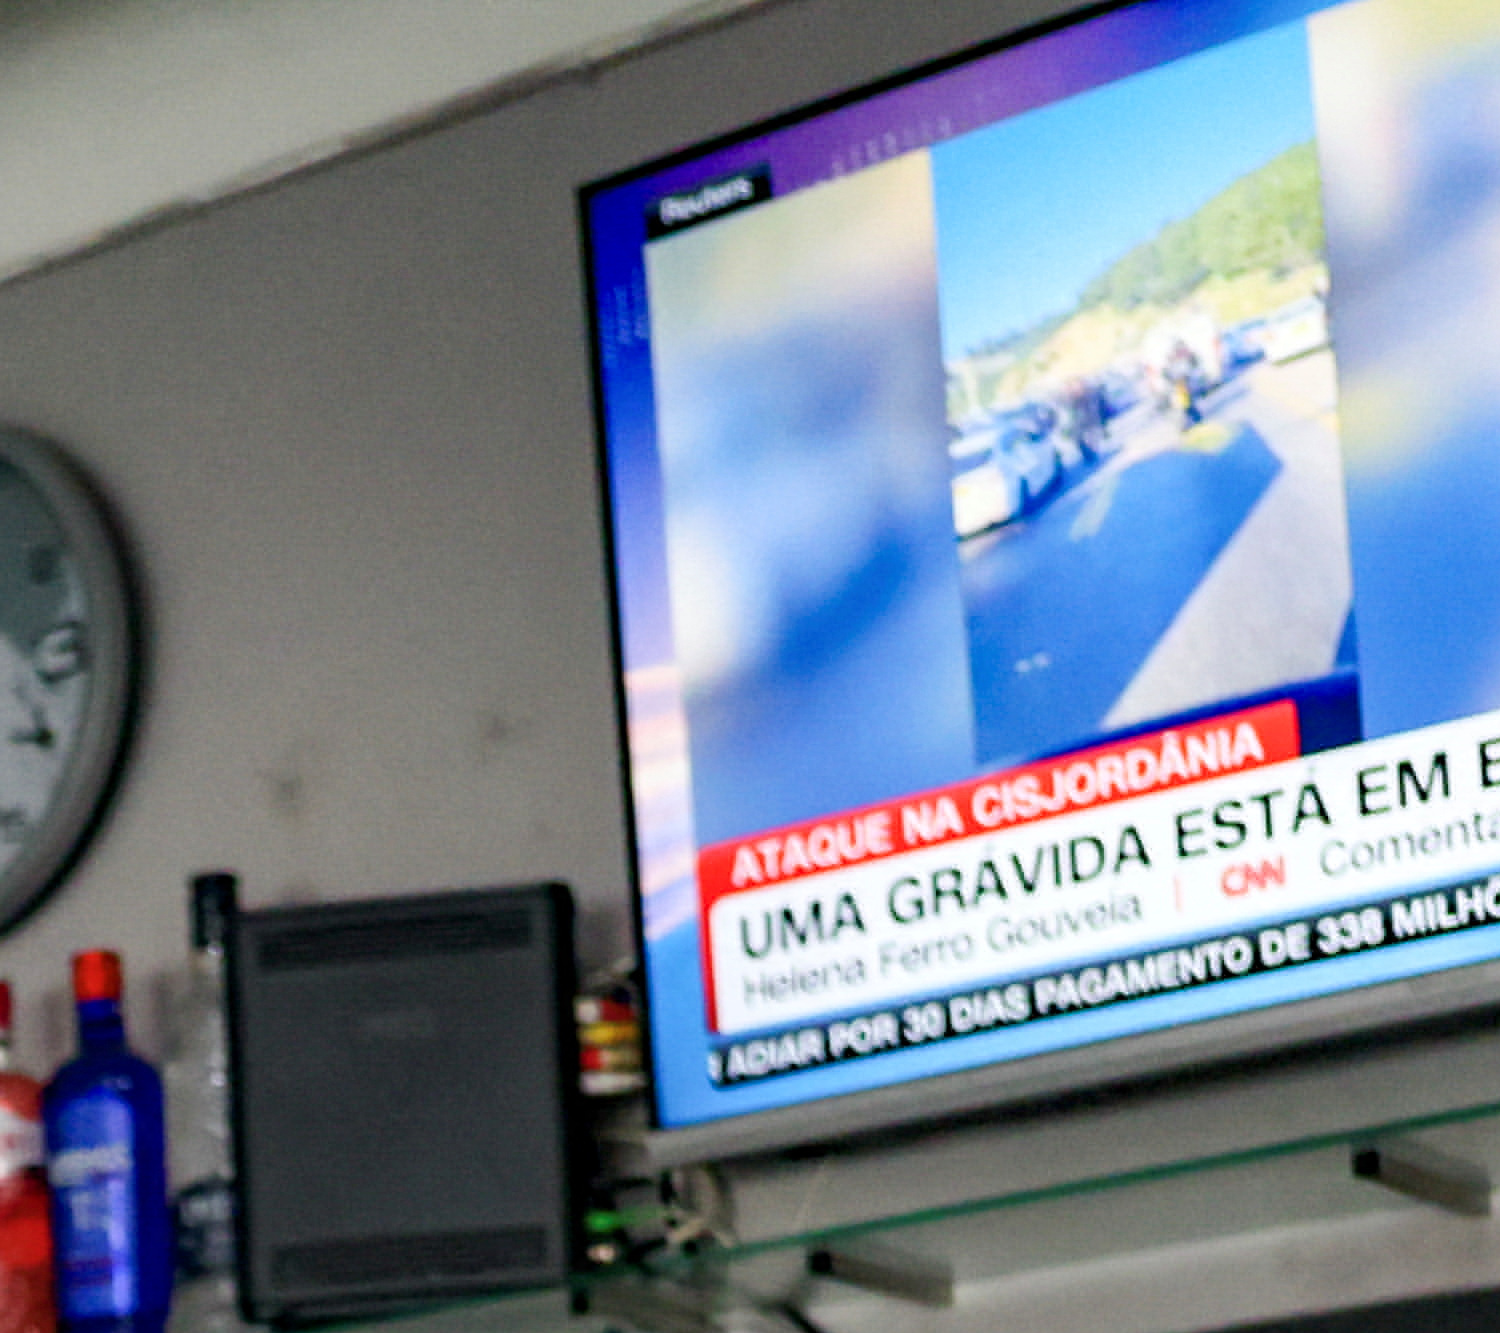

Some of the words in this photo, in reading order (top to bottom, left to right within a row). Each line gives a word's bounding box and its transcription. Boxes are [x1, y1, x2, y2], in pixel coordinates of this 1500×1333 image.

[729, 815, 893, 888] ATAQUE
[903, 796, 963, 839] NA
[973, 722, 1264, 829] CISJORDÂNIA
[739, 892, 867, 960] UMA
[888, 826, 1150, 925] GRÁVIDA
[1175, 768, 1331, 860] ESTÁ
[1356, 751, 1451, 817] EM
[1221, 857, 1286, 898] CNN
[726, 1030, 825, 1083] ADIAR
[829, 1012, 898, 1058] POR
[902, 1001, 947, 1042] 30
[949, 983, 1030, 1034] DIAS
[1035, 937, 1251, 1016] PAGAMENTO
[1259, 926, 1312, 969] DE
[1317, 911, 1388, 954] 338
[742, 955, 865, 1008] Helena
[880, 933, 974, 975] Ferro
[985, 892, 1144, 956] Gouveia
